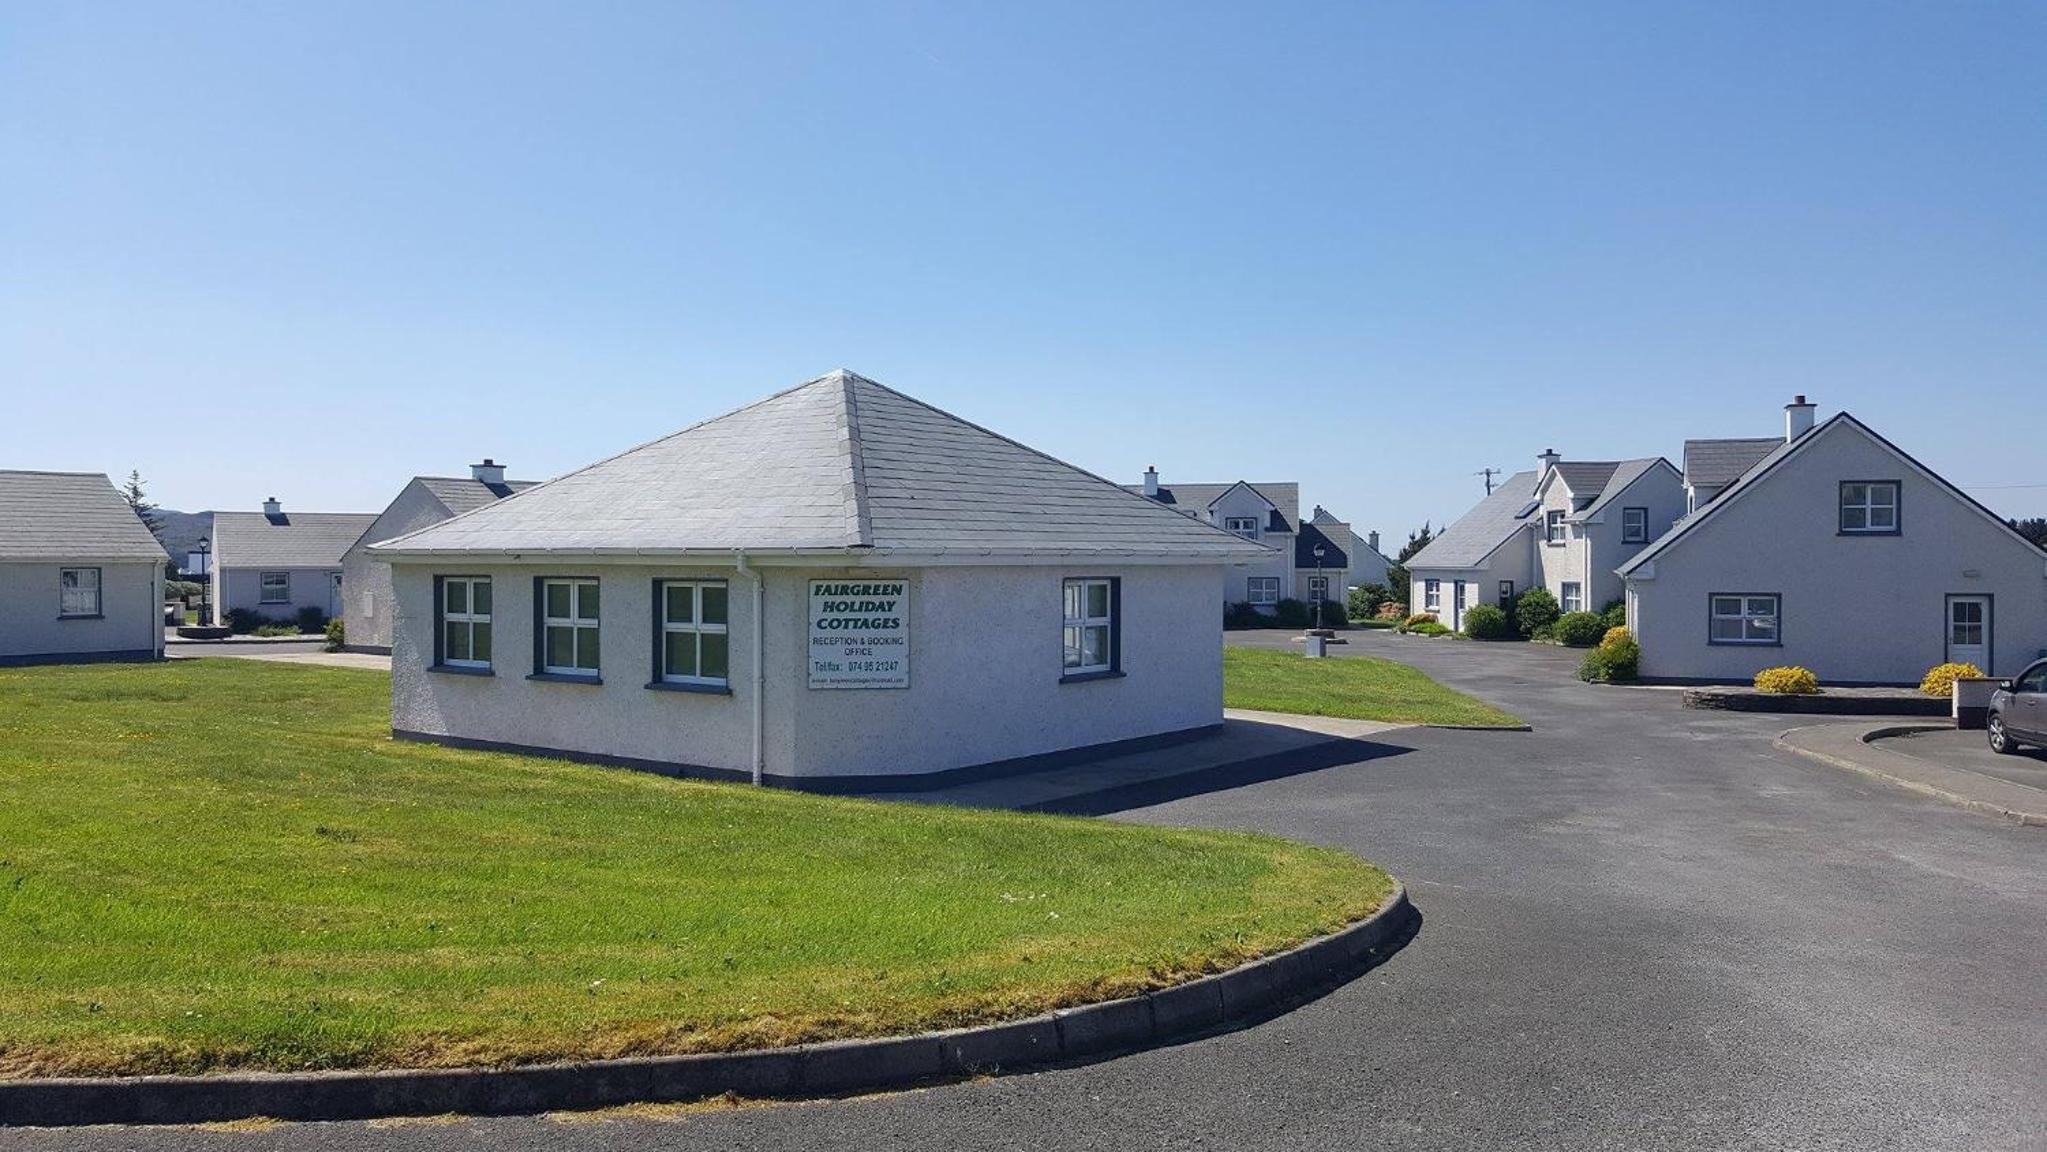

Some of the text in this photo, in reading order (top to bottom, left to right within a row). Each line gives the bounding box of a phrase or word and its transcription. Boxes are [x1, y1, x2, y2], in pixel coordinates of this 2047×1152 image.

[814, 583, 903, 596] FAIRGREEN
[822, 601, 896, 613] HOLIDAY
[816, 617, 900, 630] COTTAGES
[812, 637, 904, 646] RECEPTION & BOOKING
[844, 648, 873, 656] OFFICE
[848, 661, 862, 672] 074
[875, 661, 899, 672] 21247
